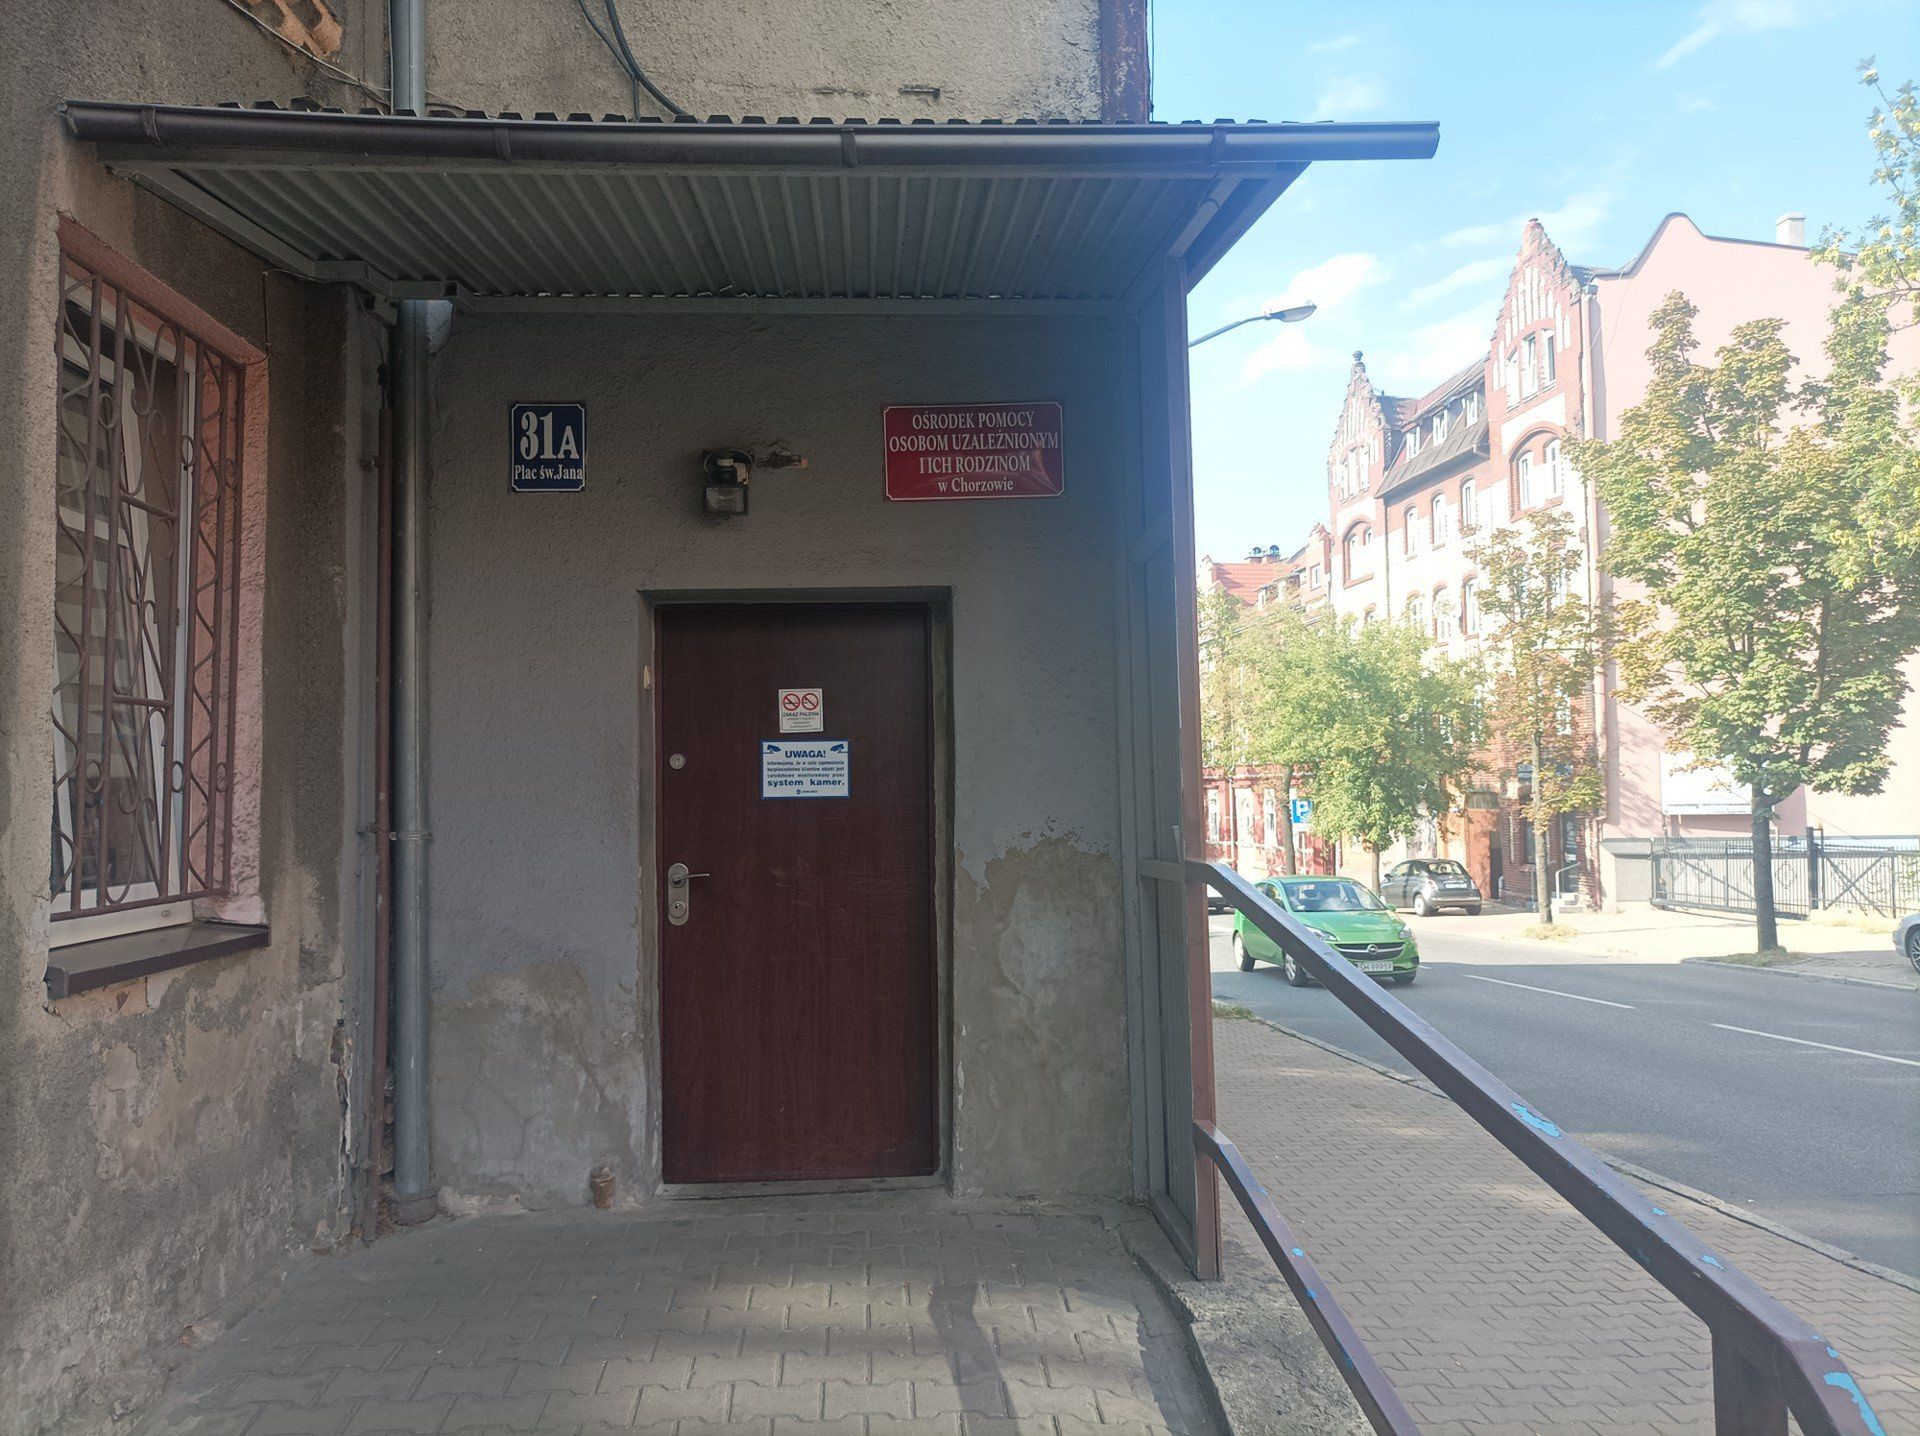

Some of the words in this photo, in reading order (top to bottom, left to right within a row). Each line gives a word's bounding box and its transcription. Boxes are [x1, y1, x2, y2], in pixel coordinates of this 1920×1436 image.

[912, 411, 976, 430] OŚRODEK
[979, 411, 1035, 428] POMOCY
[520, 411, 580, 460] 31A
[889, 435, 949, 452] OSOBOM
[951, 429, 1059, 451] UZALEŻNIONYM
[514, 464, 537, 480] Plac
[919, 457, 925, 474] I
[926, 456, 951, 473] ICH
[956, 455, 1031, 473] RODZINOM
[937, 481, 949, 492] w
[951, 476, 1014, 493] Chorzowie
[785, 750, 826, 758] UWAGA!
[767, 779, 804, 787] system
[809, 778, 845, 786] kamer.
[1296, 801, 1309, 816] P
